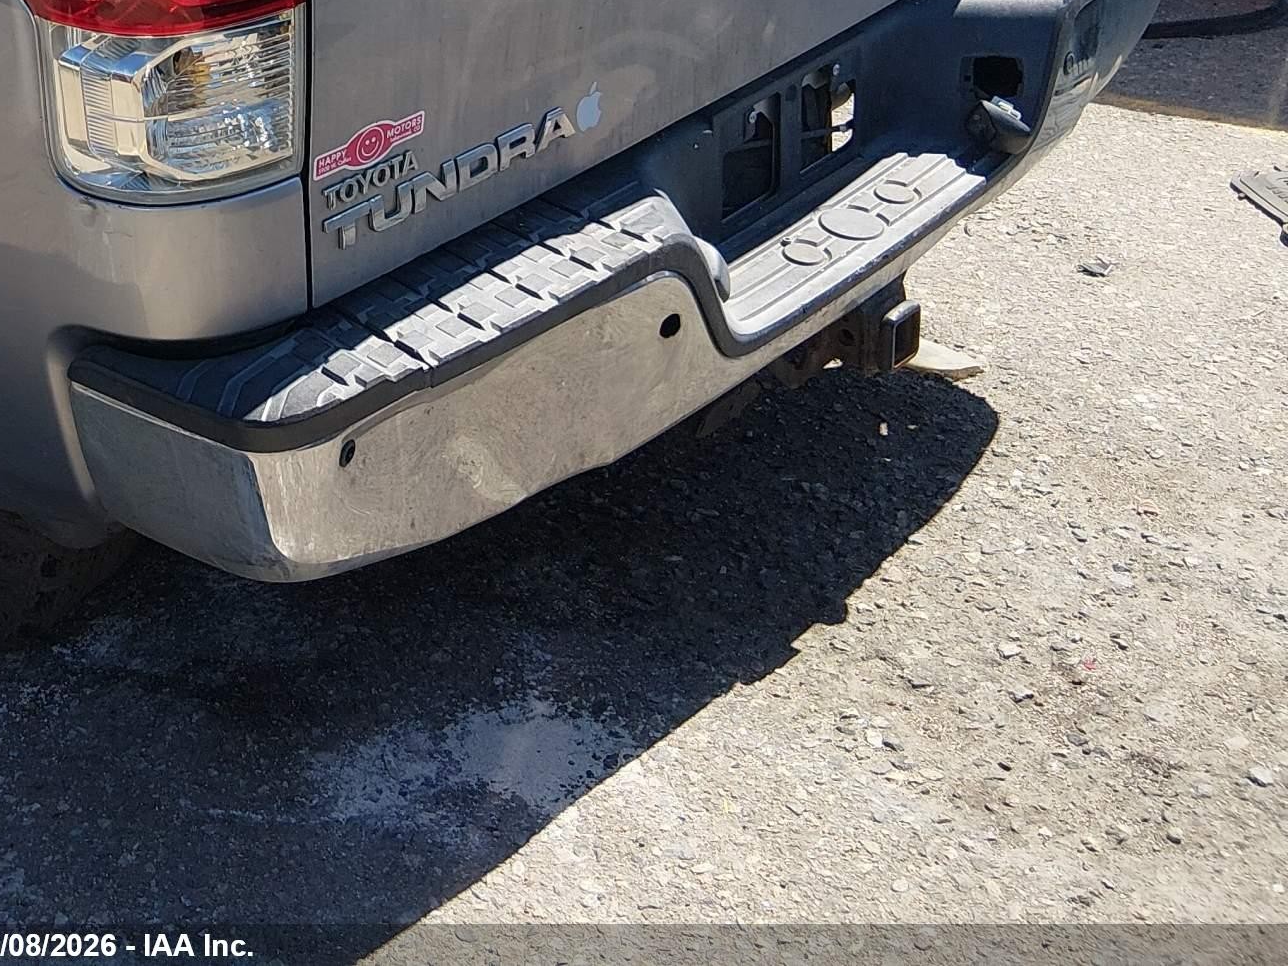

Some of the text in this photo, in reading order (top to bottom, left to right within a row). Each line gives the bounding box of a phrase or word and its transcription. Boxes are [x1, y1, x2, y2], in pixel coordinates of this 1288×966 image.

[318, 149, 347, 168] HAPPY
[386, 116, 422, 139] MOTORS
[322, 150, 420, 210] TOYOTA
[323, 106, 577, 251] TUNDRA
